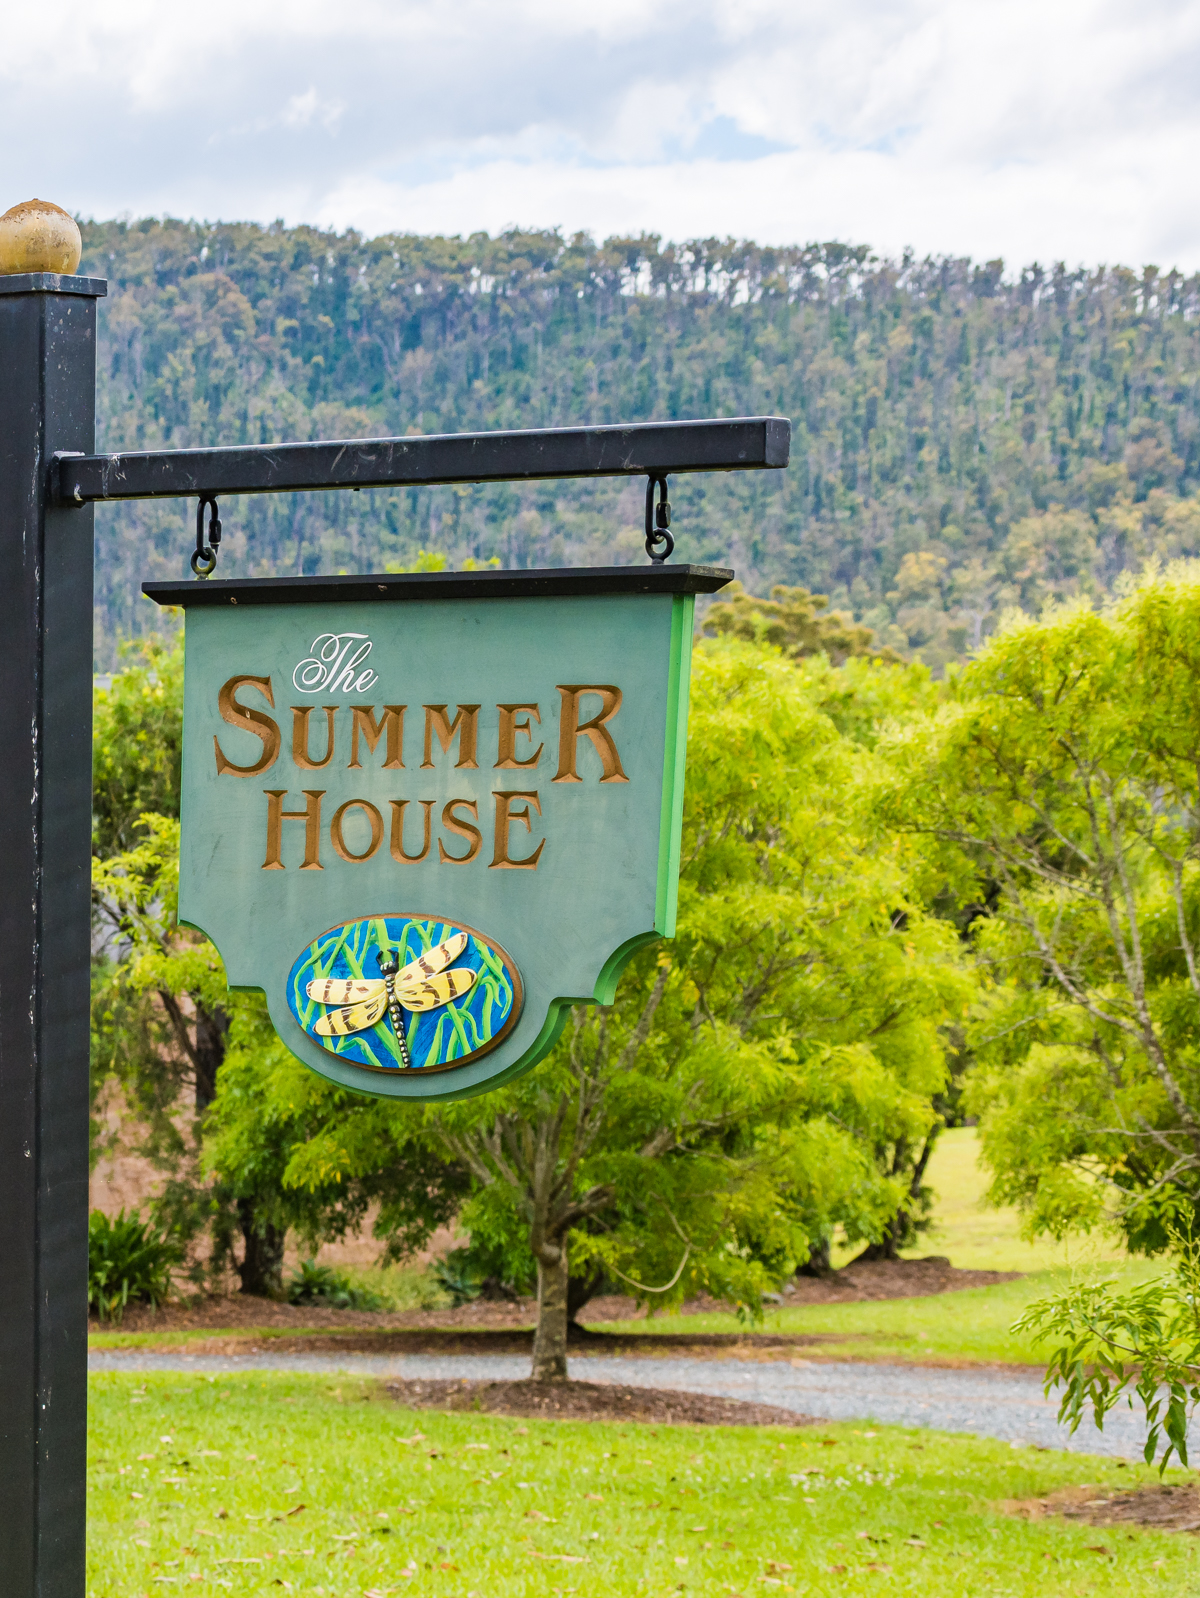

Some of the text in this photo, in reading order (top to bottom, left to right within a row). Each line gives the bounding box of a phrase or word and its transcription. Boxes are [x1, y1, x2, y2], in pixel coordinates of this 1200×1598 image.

[292, 632, 379, 694] The
[213, 674, 630, 783] SUMMER
[261, 789, 546, 871] HOUSE
